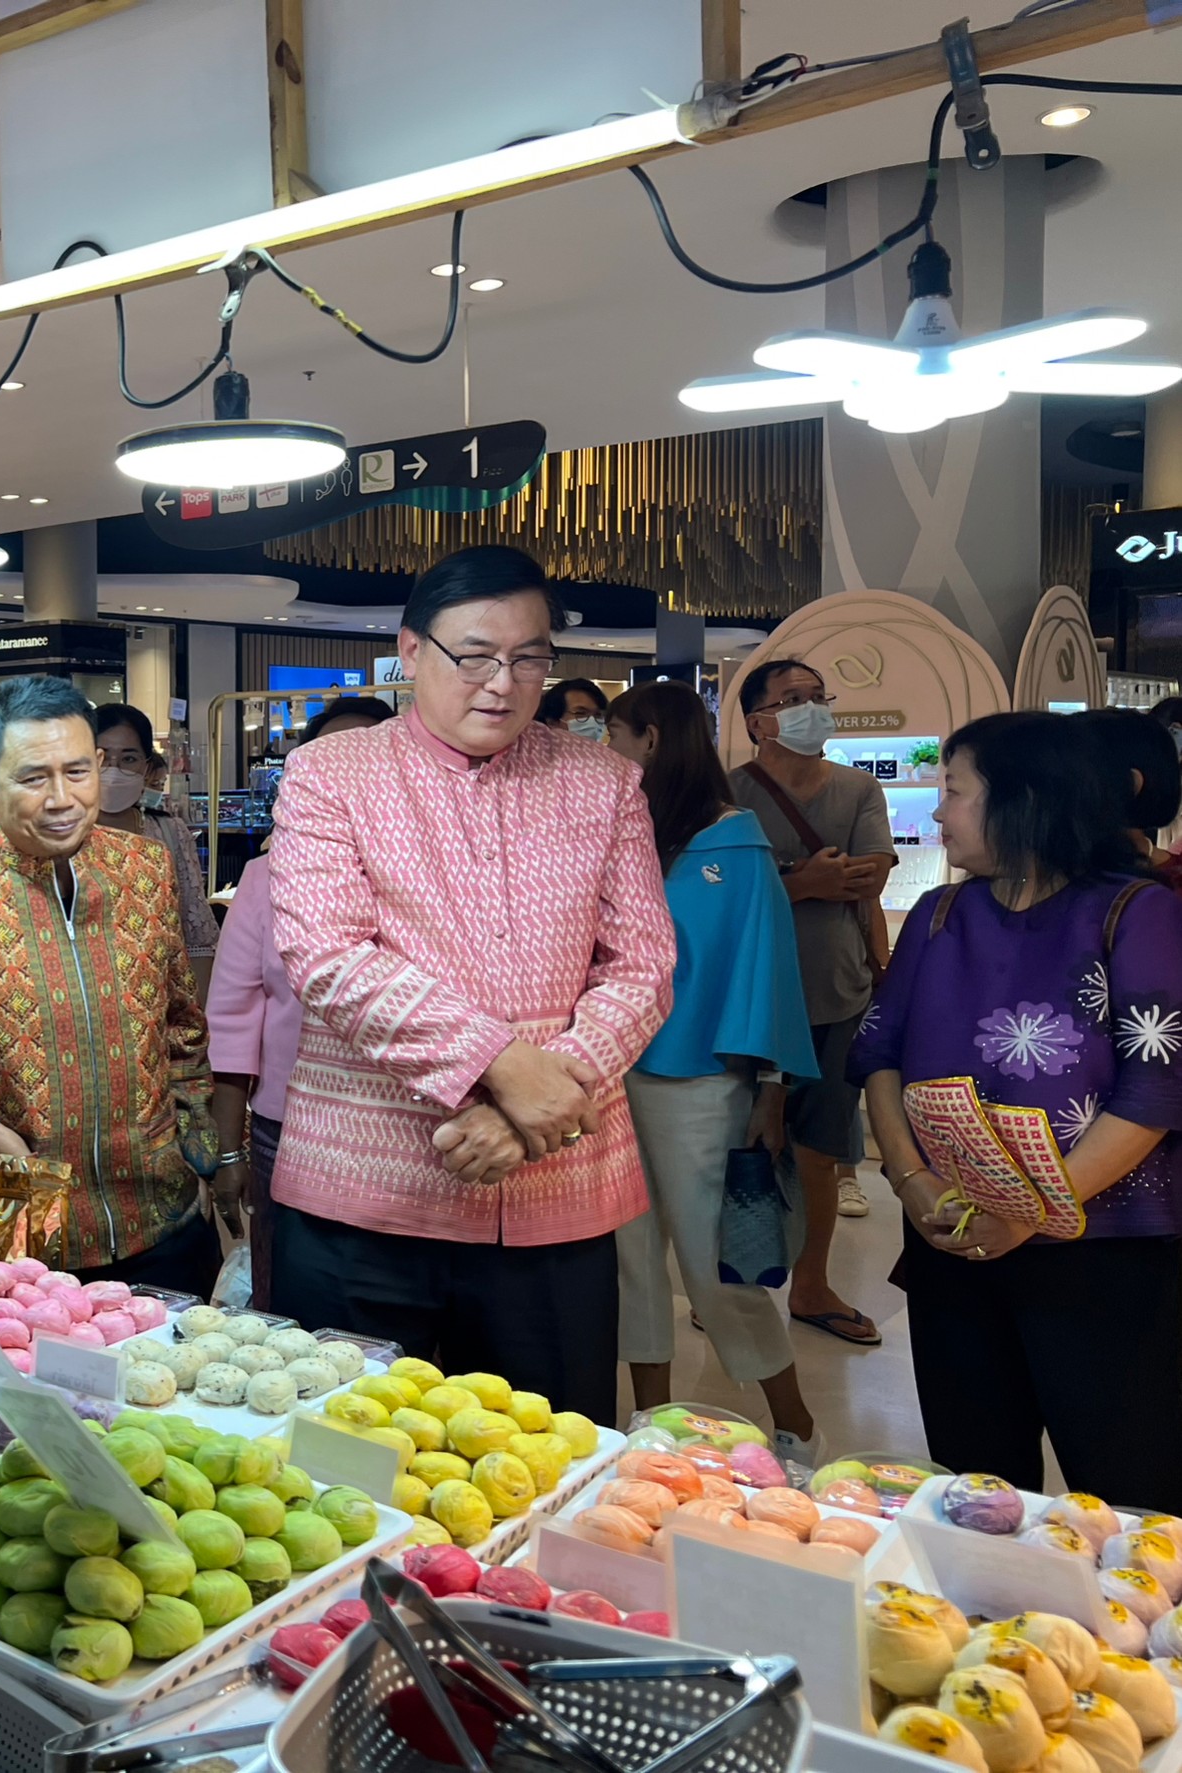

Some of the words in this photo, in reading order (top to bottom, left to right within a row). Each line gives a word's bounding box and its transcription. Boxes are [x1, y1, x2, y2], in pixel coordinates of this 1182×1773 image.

[461, 436, 479, 479] 1
[183, 492, 210, 505] Tops
[221, 493, 246, 503] PARK
[861, 714, 900, 729] 92.5%
